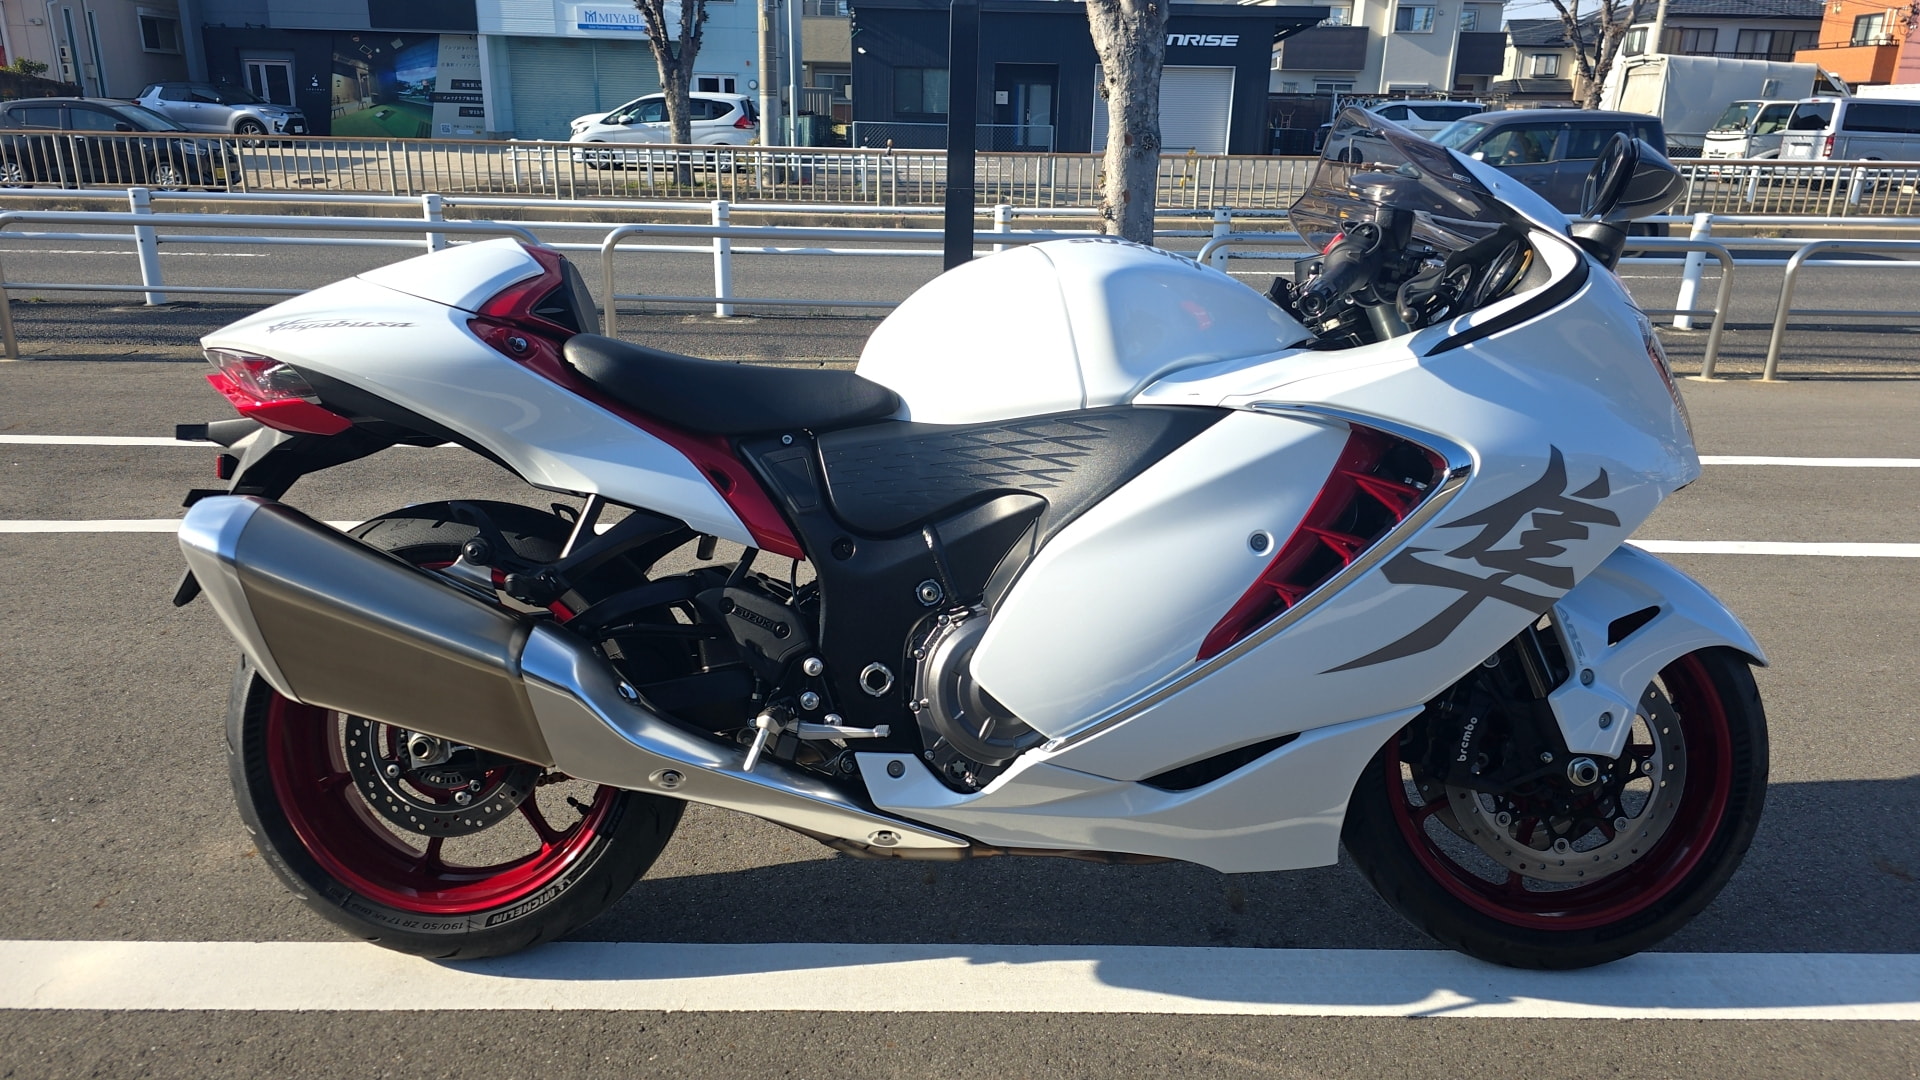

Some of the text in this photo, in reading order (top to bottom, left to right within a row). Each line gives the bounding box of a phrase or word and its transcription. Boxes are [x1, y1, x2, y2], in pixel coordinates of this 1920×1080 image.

[598, 13, 640, 24] MIYABI
[1166, 34, 1240, 47] NRISE
[734, 606, 774, 631] SUZUKI
[1558, 607, 1587, 662] ABS
[1456, 716, 1479, 763] brembo
[491, 887, 556, 925] MICHELIN
[387, 917, 401, 926] 17
[402, 919, 420, 929] ZR
[422, 921, 464, 931] 190/50
